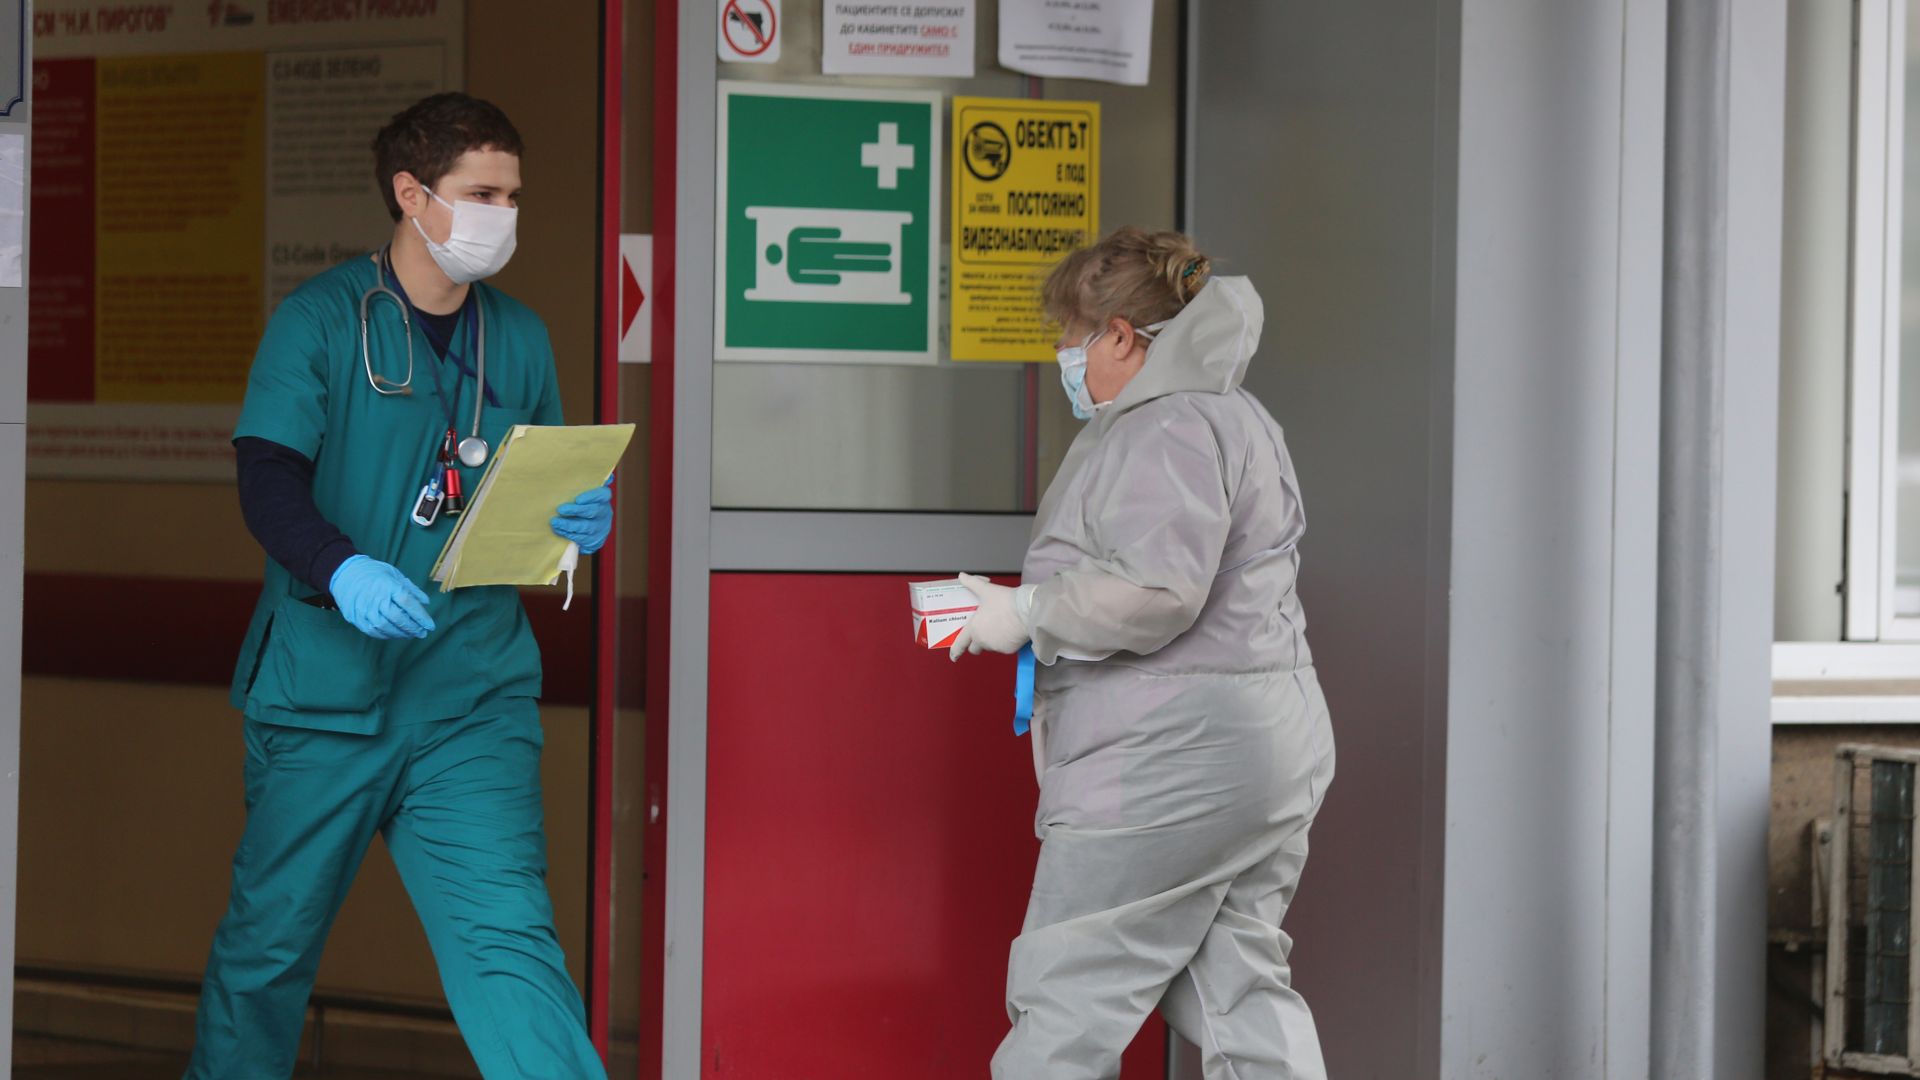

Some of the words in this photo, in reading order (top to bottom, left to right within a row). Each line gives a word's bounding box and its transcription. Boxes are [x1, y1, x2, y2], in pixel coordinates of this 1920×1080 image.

[1016, 119, 1087, 149] ОБЕКТЪТ
[1056, 163, 1063, 182] Е
[1066, 163, 1085, 184] ПОД
[1008, 191, 1085, 217] ПОСТОЯННО
